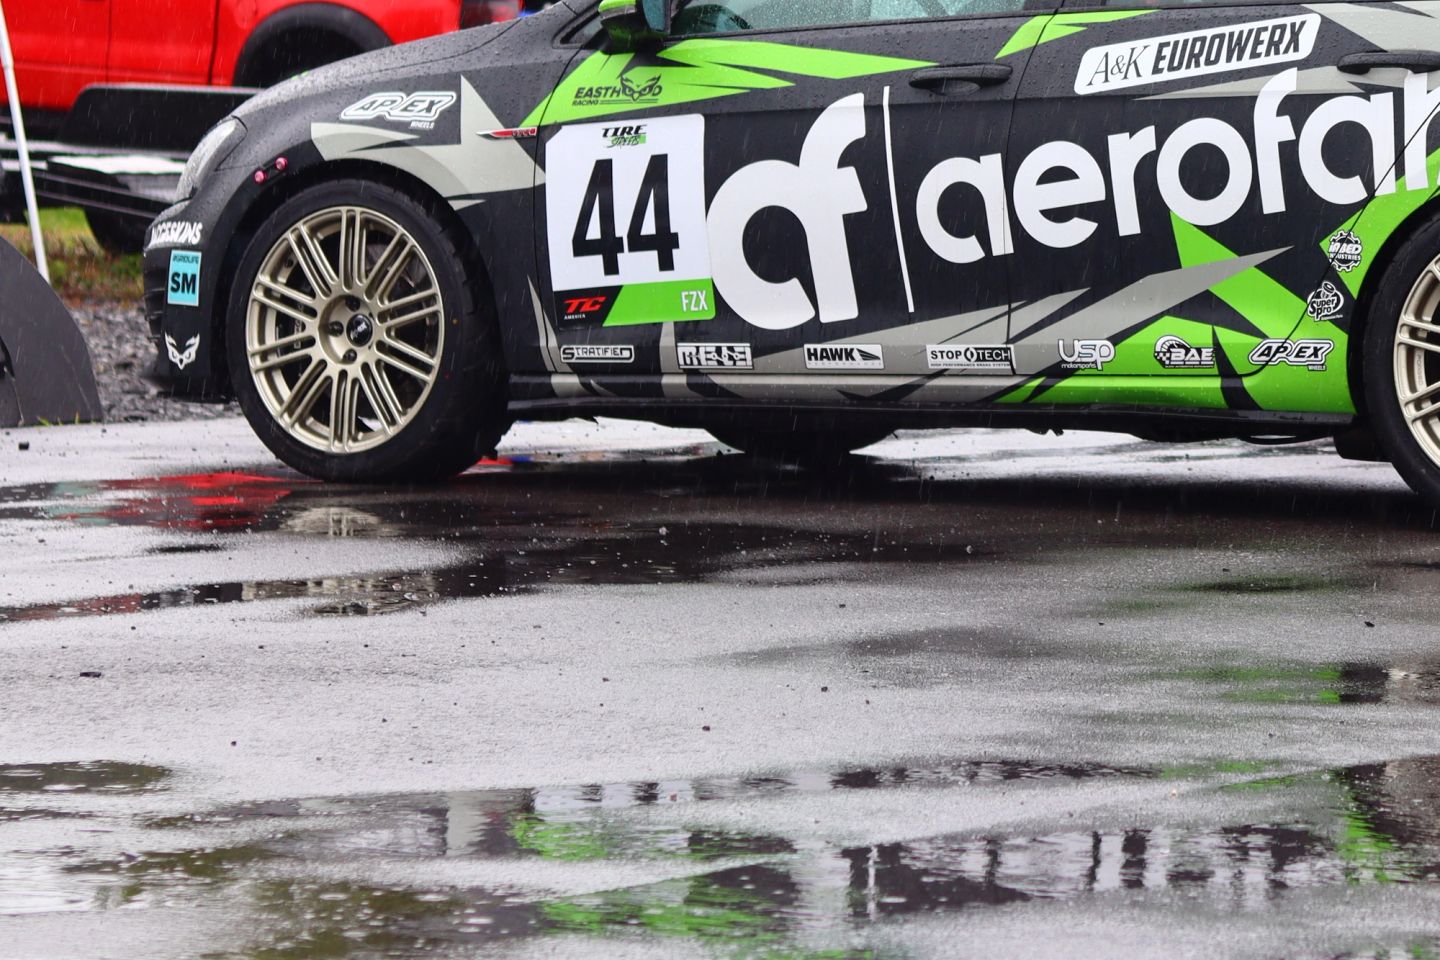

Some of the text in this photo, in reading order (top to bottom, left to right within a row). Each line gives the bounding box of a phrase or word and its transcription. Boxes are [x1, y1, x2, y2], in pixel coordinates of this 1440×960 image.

[1086, 20, 1307, 86] A&K EUROWERX
[350, 93, 455, 118] APEX
[572, 99, 599, 107] RACING
[601, 124, 648, 138] TIRE
[572, 153, 680, 276] 44
[169, 271, 198, 295] SM
[681, 289, 708, 312] FZX
[806, 348, 857, 361] HAWK
[930, 349, 1011, 361] STOP TECH
[1170, 347, 1214, 361] BAE
[1256, 342, 1331, 361] APEX
